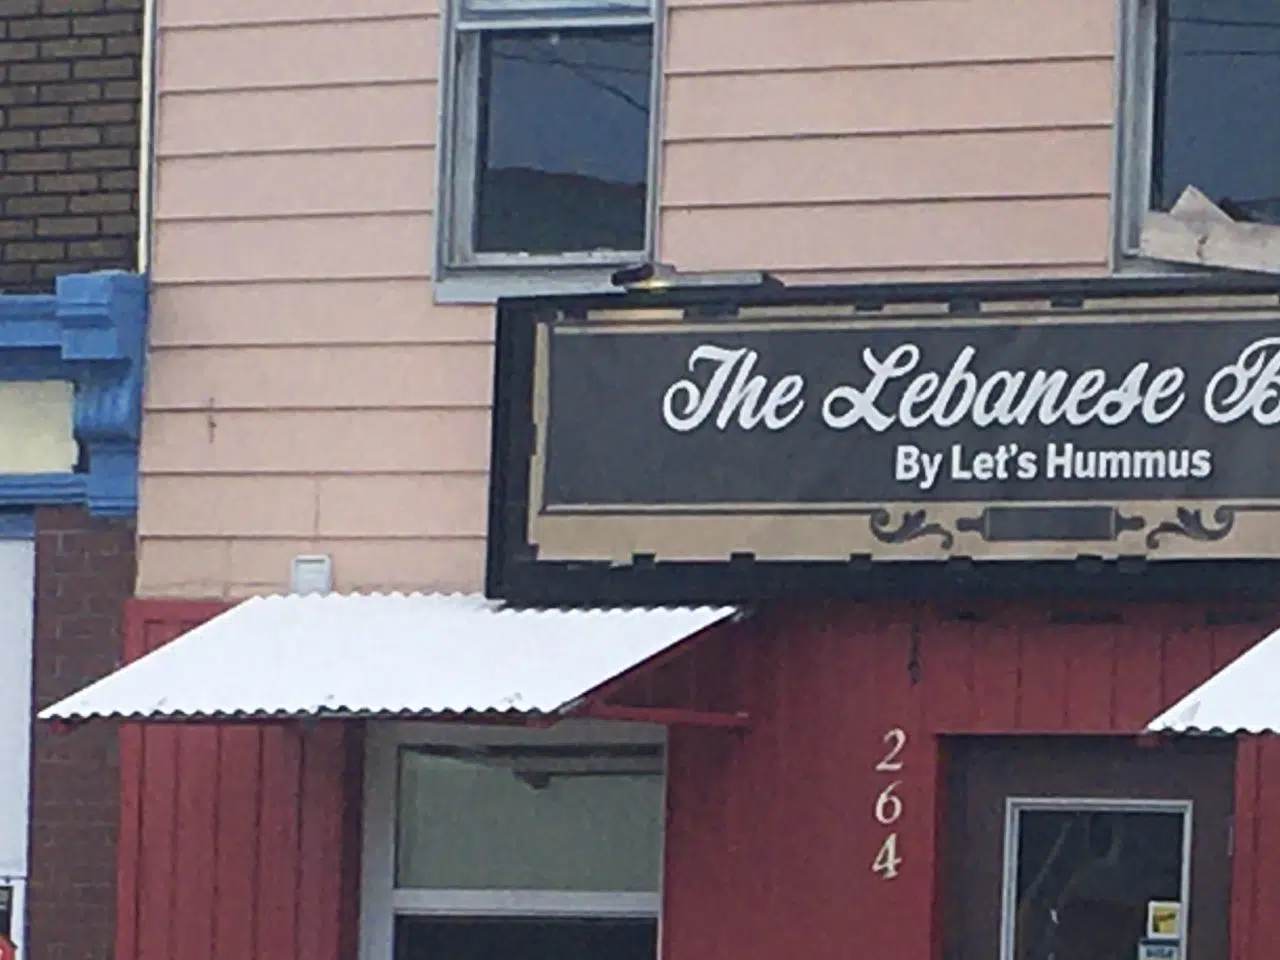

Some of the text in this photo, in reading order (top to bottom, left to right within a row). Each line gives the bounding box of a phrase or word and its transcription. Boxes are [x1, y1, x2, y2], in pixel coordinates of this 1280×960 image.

[663, 344, 804, 431] The
[822, 344, 1186, 432] Lebanese
[895, 443, 1213, 490] By Let's Hummus
[871, 727, 907, 880] 264
